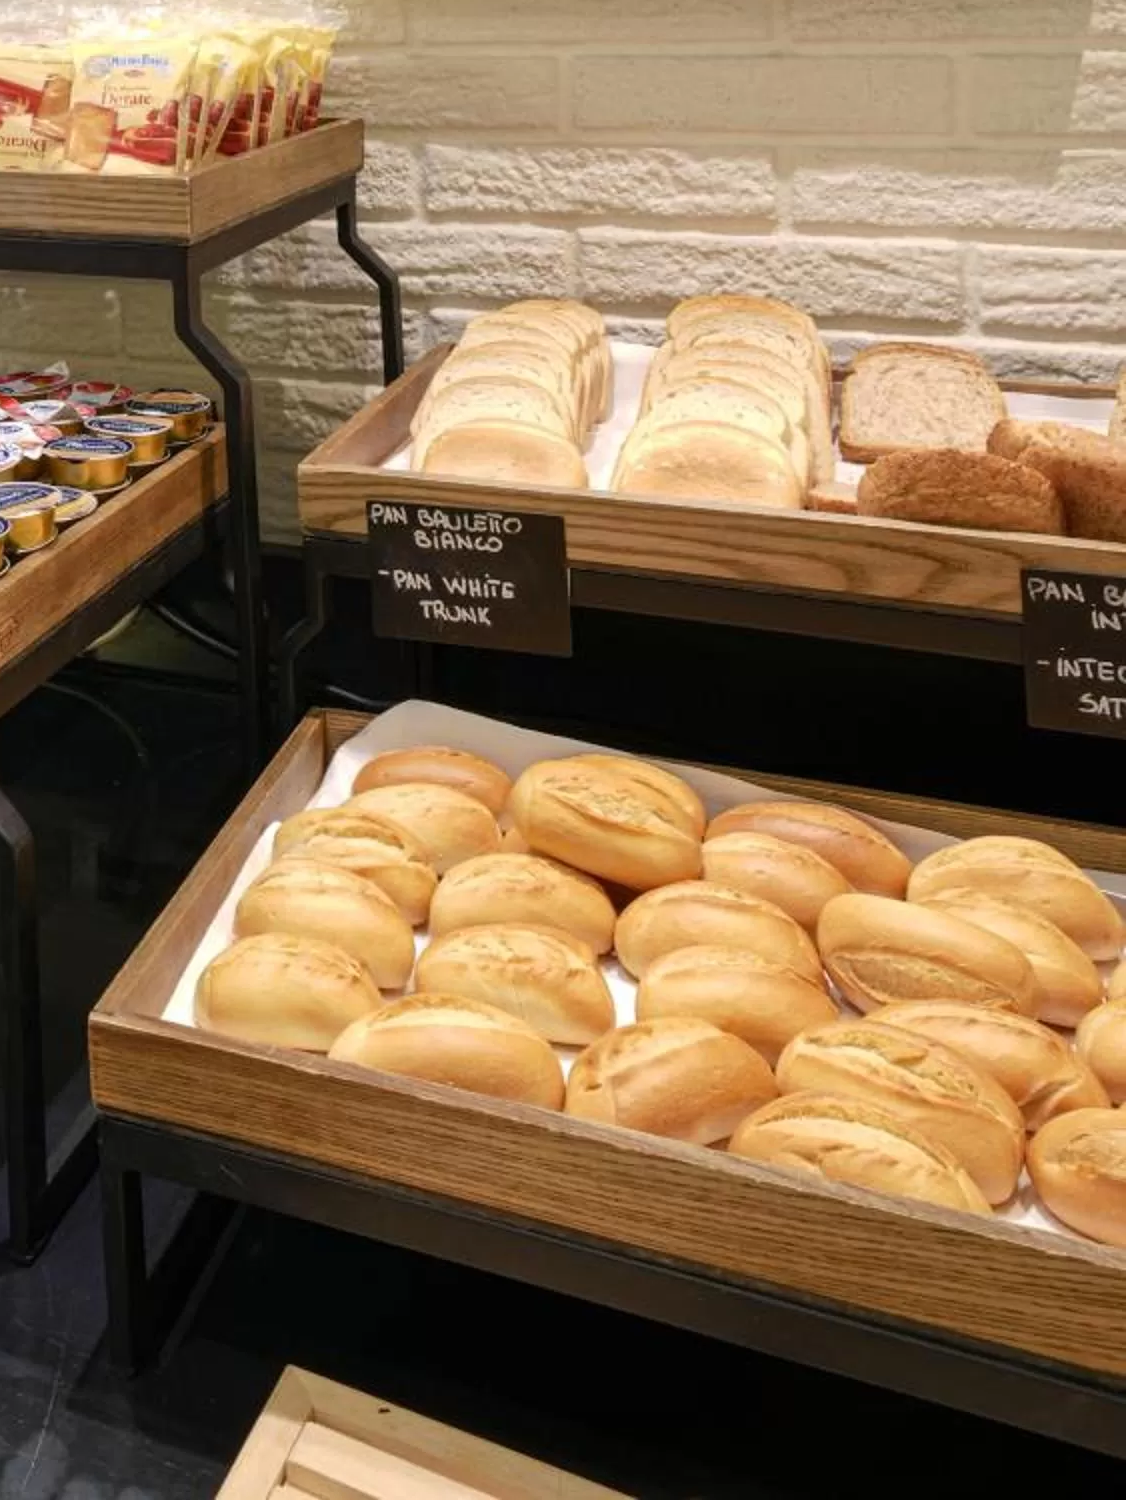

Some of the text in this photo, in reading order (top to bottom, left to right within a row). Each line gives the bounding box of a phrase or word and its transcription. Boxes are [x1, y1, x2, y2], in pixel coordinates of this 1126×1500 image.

[370, 503, 523, 534] PAN BAULETTO
[1027, 577, 1085, 603] PAN
[419, 599, 492, 626] TRUNK
